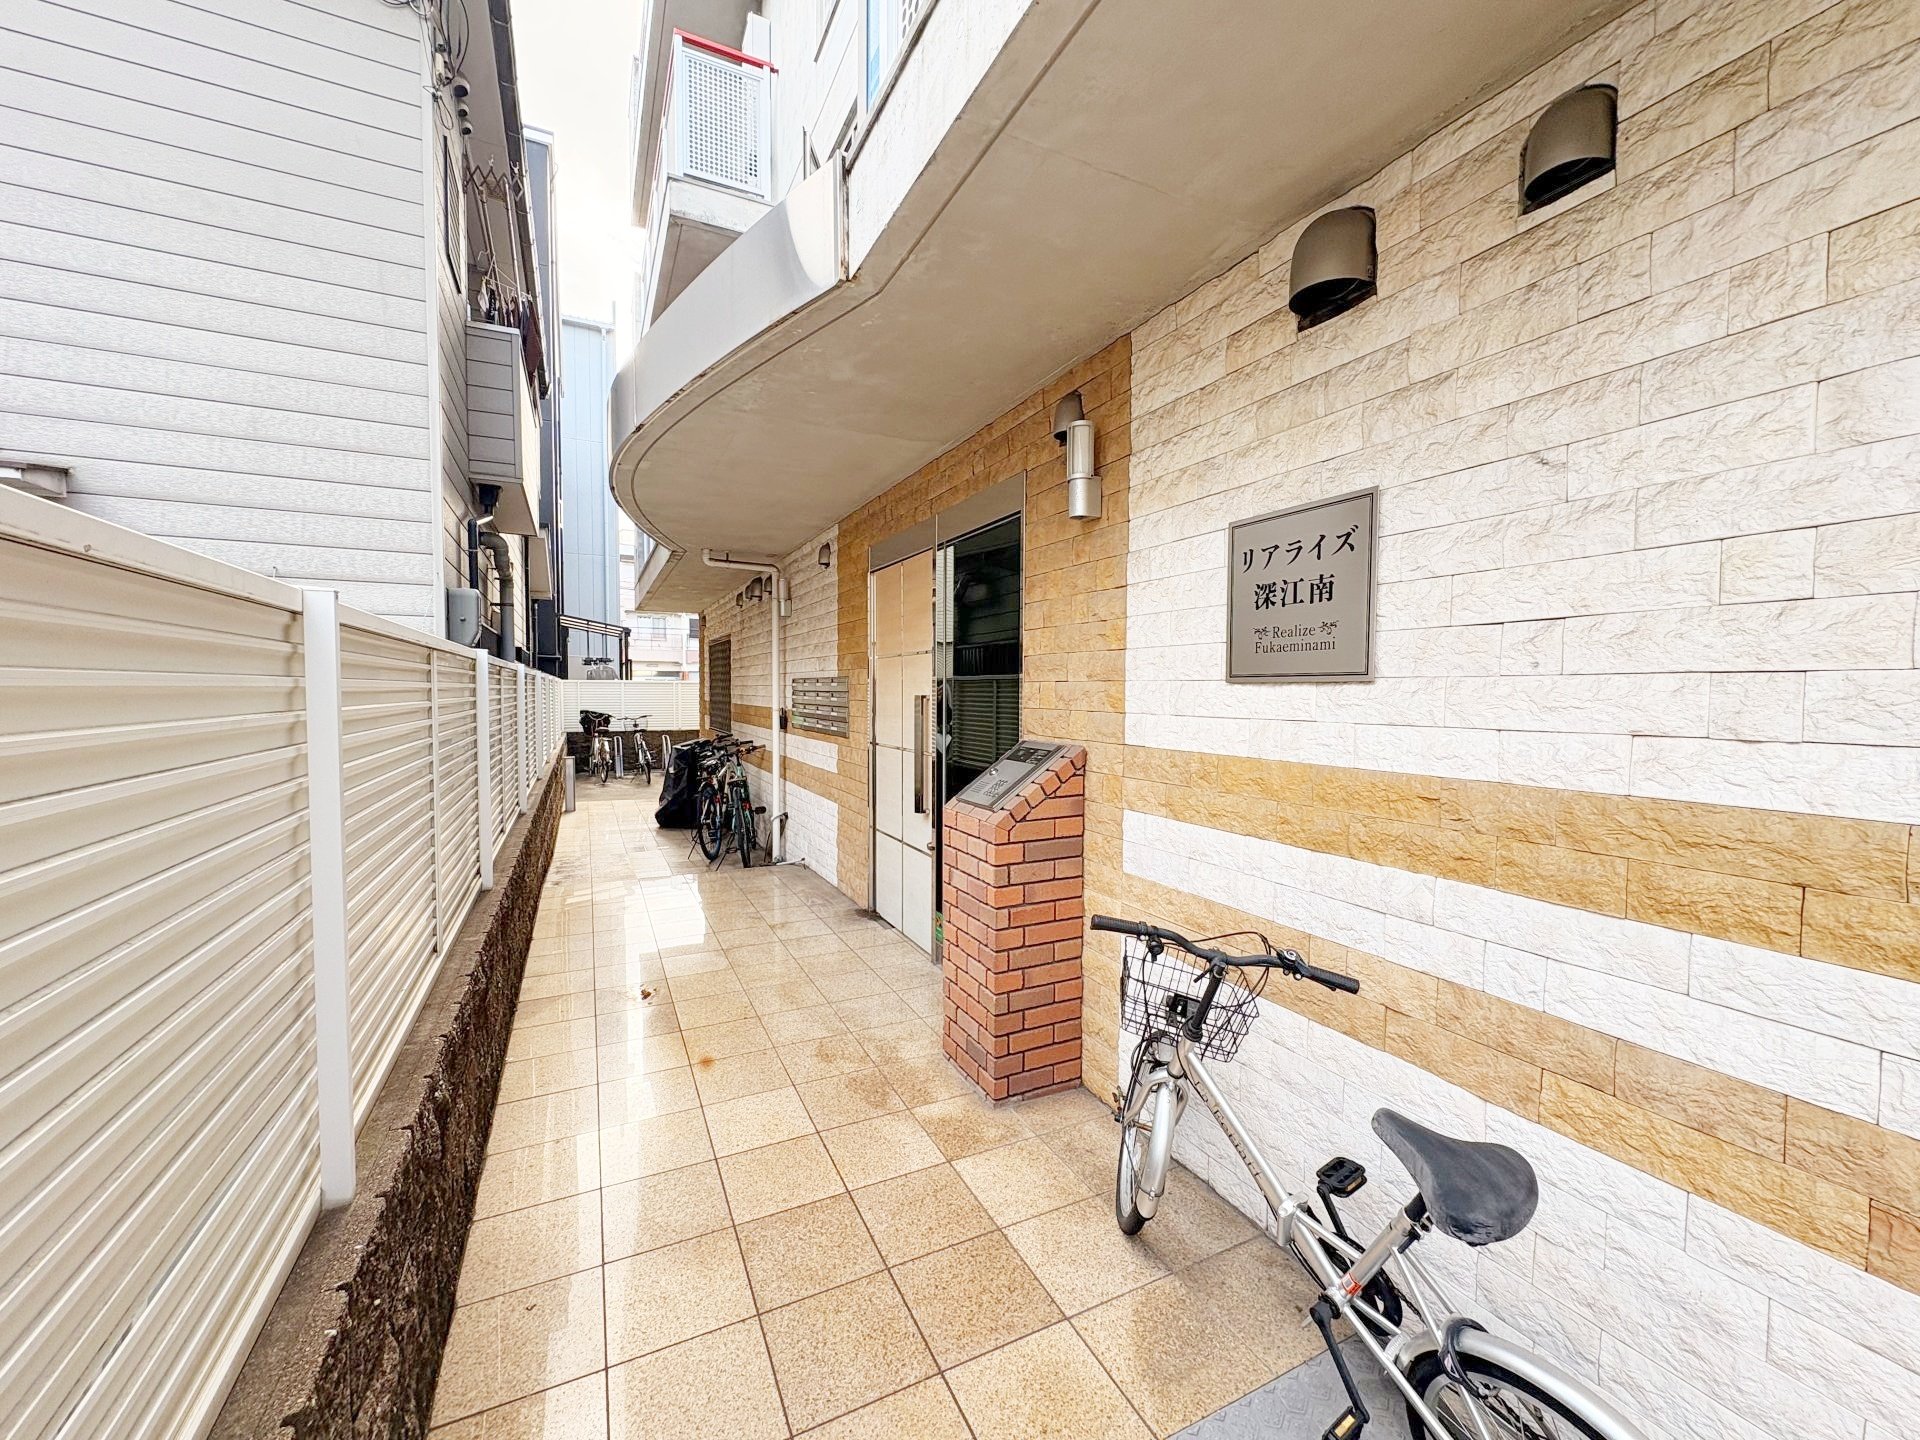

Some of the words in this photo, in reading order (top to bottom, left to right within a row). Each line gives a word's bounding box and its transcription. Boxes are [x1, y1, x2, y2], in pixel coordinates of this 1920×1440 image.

[1242, 524, 1359, 574] リアライズ
[1254, 573, 1335, 611] 深江南
[1254, 636, 1336, 654] Fukaeminami
[1272, 623, 1316, 639] Realize
